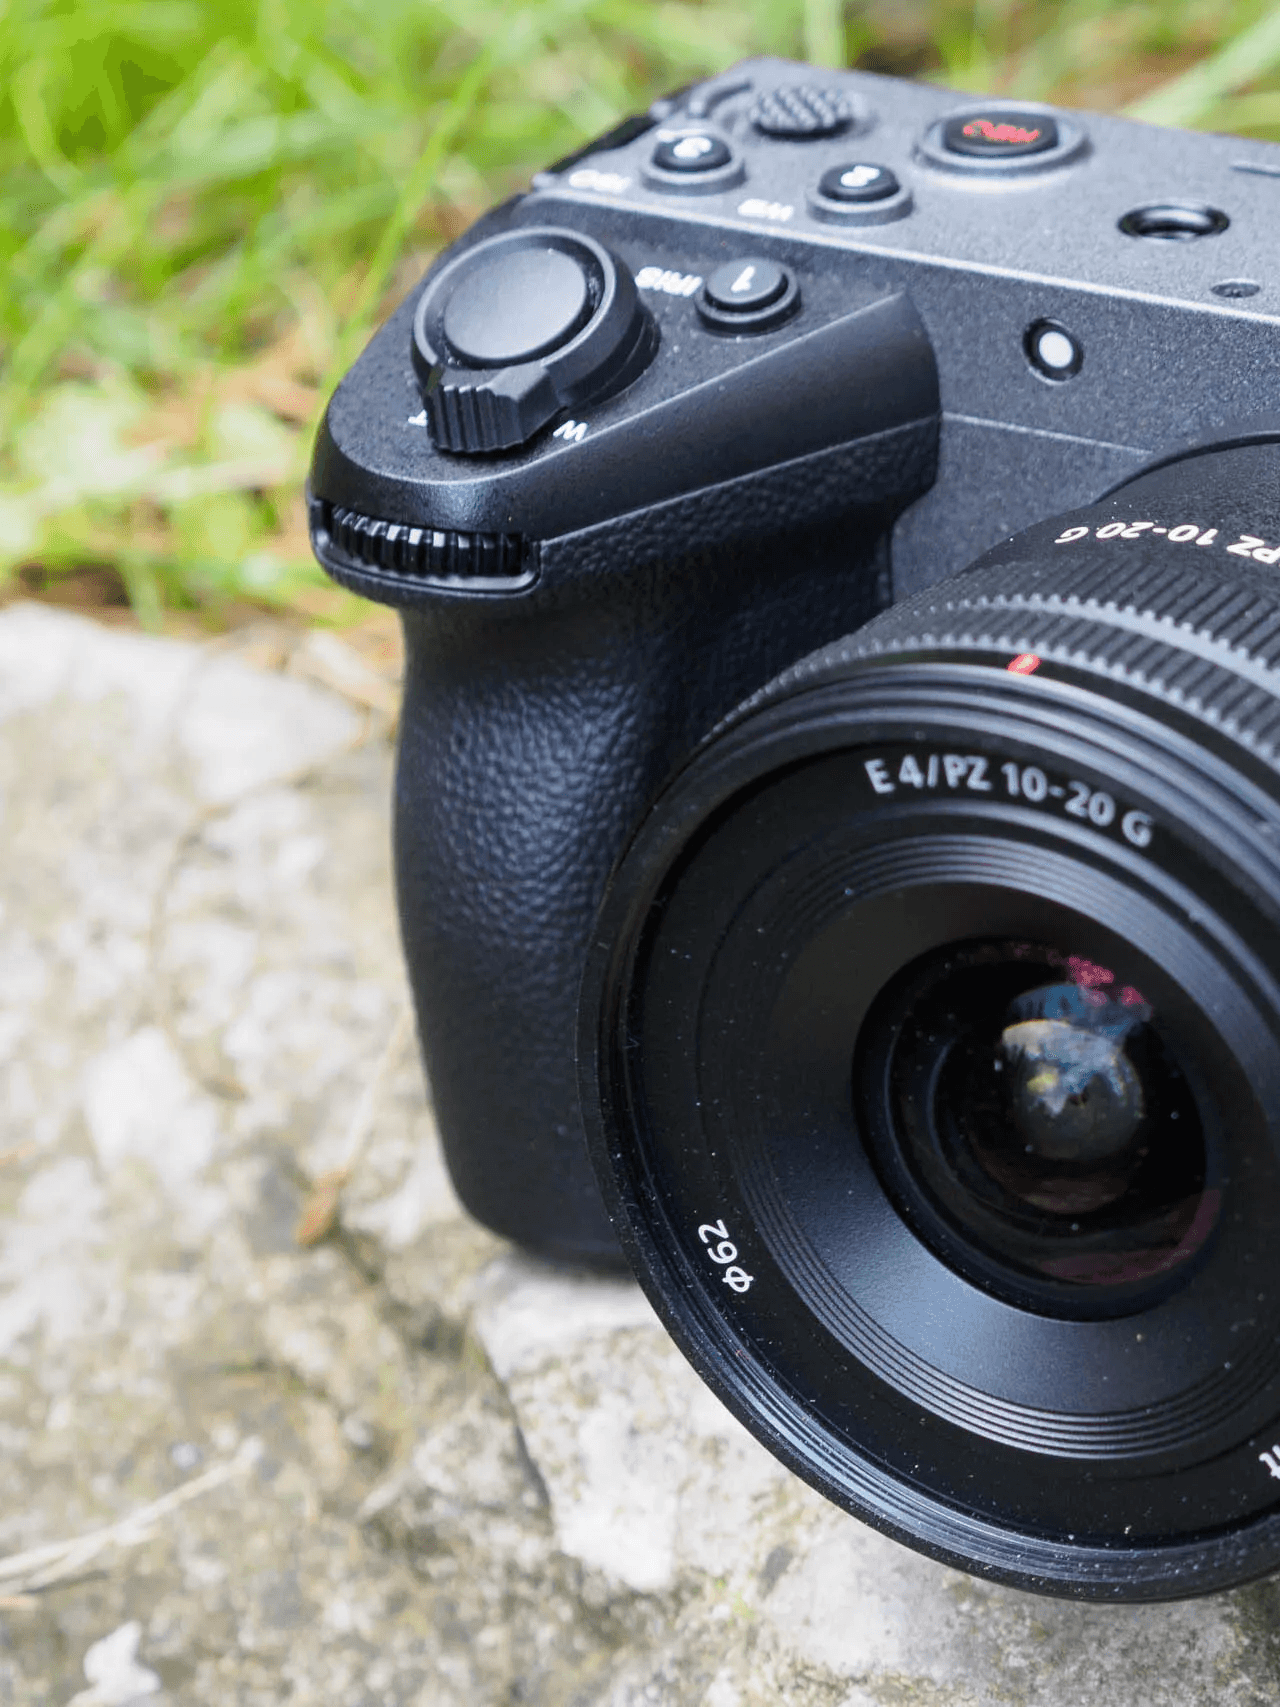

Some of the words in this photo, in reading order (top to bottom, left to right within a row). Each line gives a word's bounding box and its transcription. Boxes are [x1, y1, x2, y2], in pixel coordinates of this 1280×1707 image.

[1054, 526, 1089, 544] G
[1094, 520, 1219, 546] 10-20
[864, 758, 895, 794] E
[898, 755, 990, 791] 4/PZ
[1000, 763, 1116, 829] 10-20
[1120, 809, 1155, 848] G
